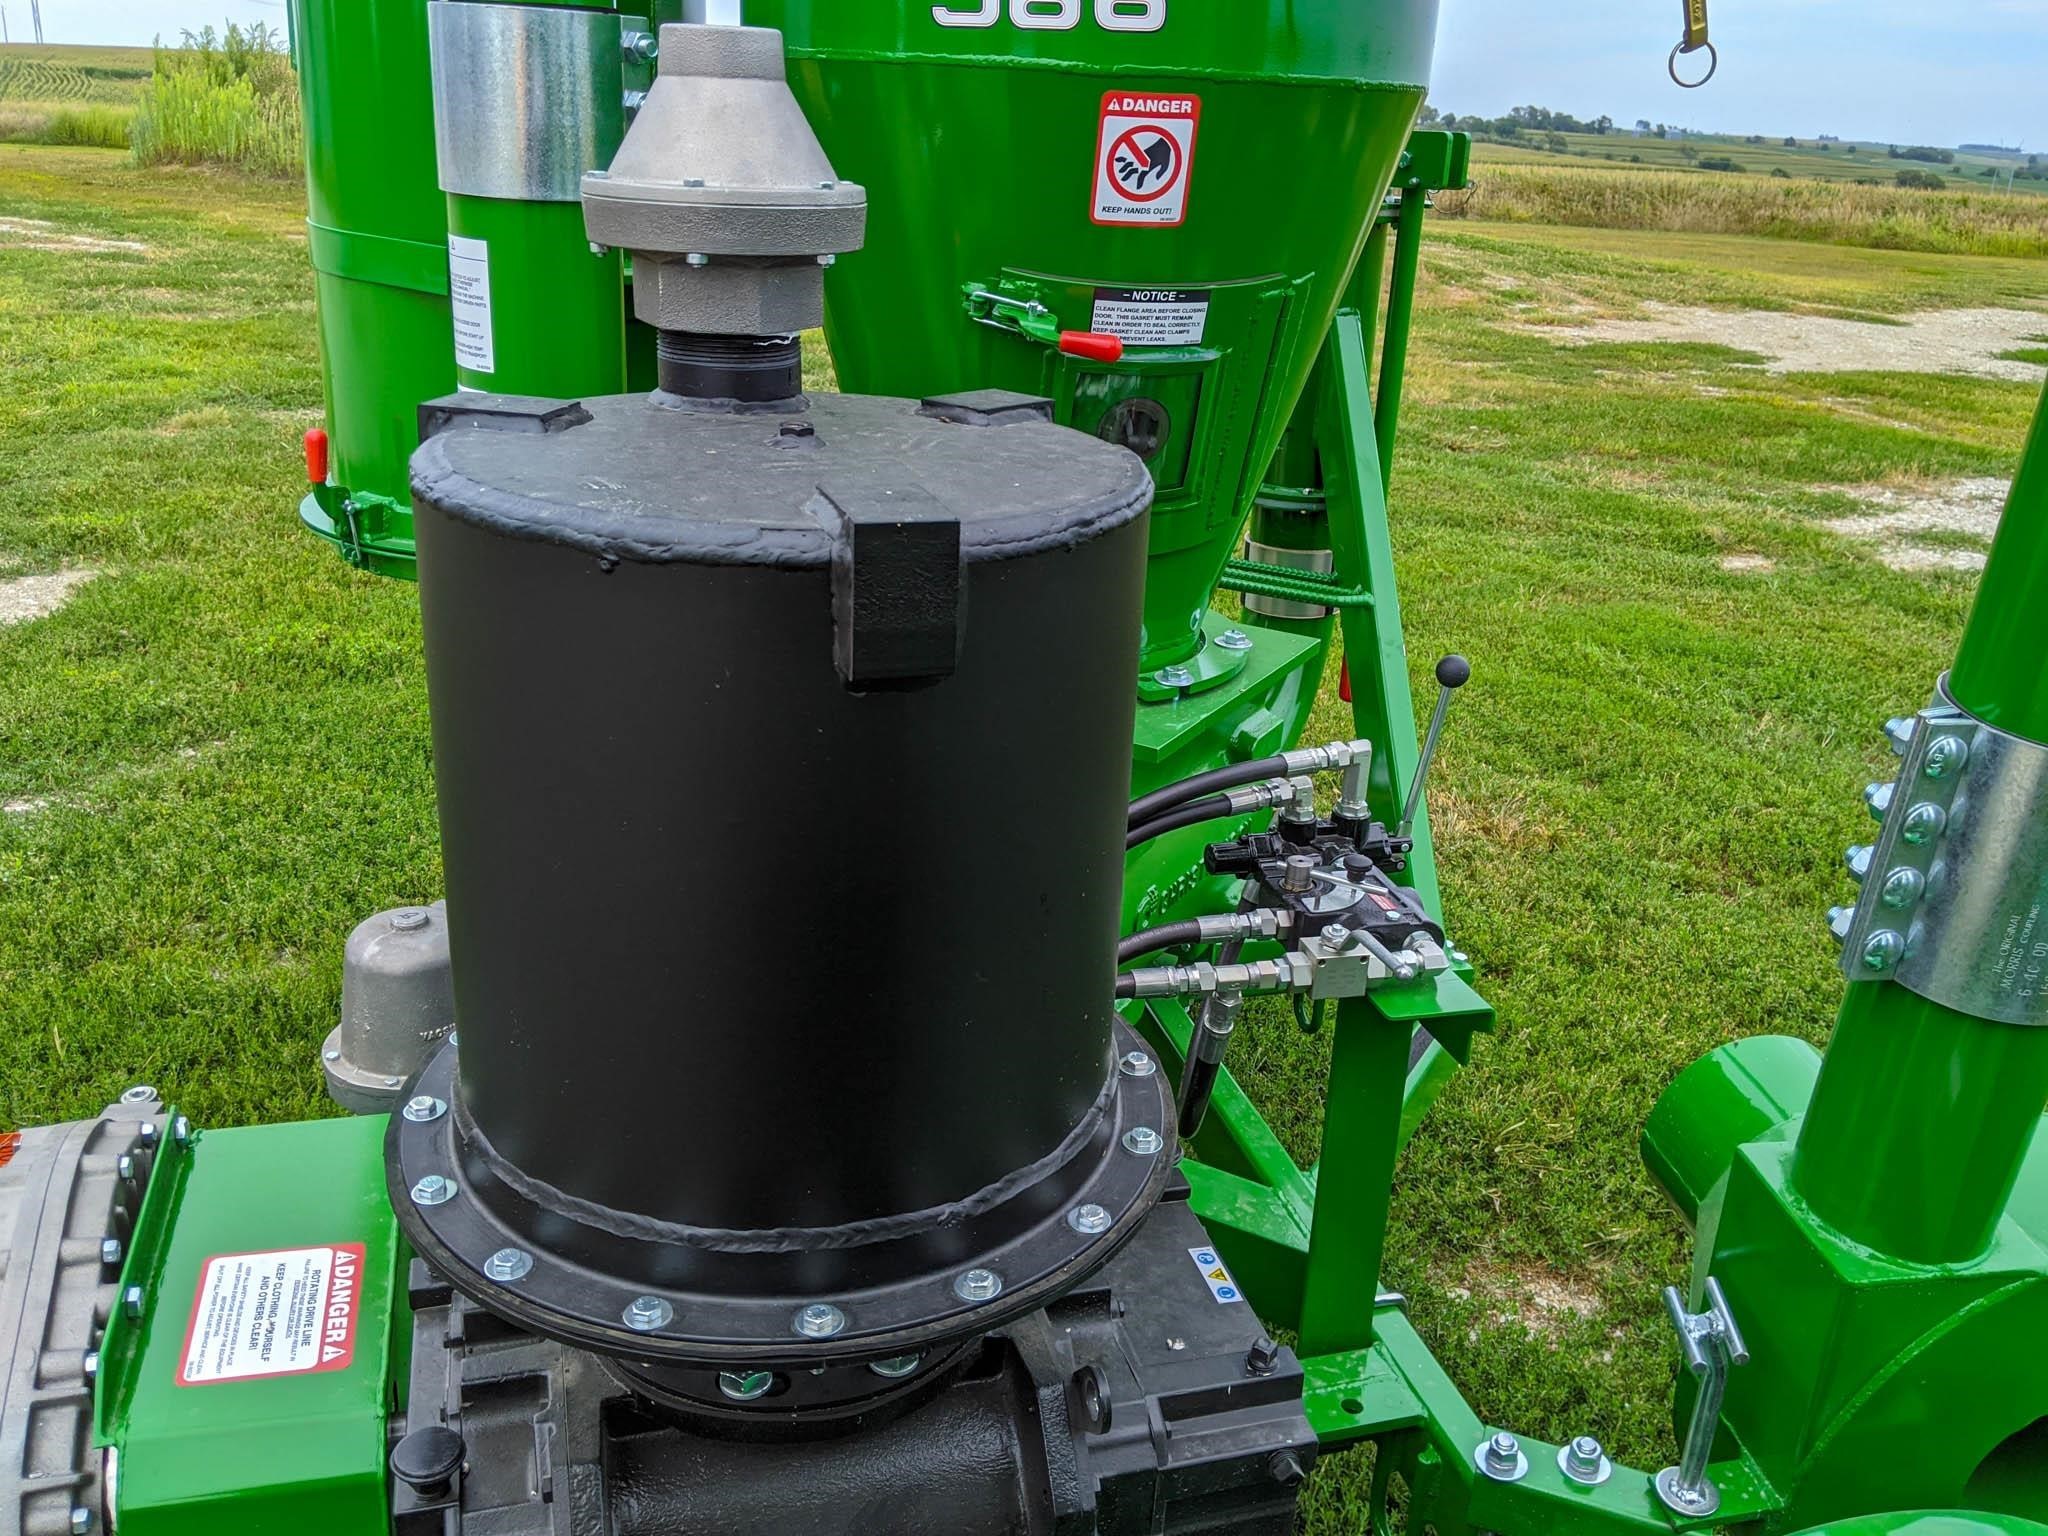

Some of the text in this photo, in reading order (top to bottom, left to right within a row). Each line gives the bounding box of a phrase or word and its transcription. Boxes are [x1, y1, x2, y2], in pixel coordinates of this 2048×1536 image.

[1123, 98, 1192, 113] DANGER
[1132, 291, 1177, 301] NOTICE
[1992, 915, 2021, 973] The ORIGINAL
[2000, 904, 2040, 989] MORRIS COUPLING
[249, 1276, 270, 1350] AND OTHERS CLEAR!
[261, 1263, 285, 1362] KEEP CLOTHING, YOURSELF
[301, 1270, 321, 1346] ROTATING DRIVE LINE
[325, 1265, 354, 1343] DANGER
